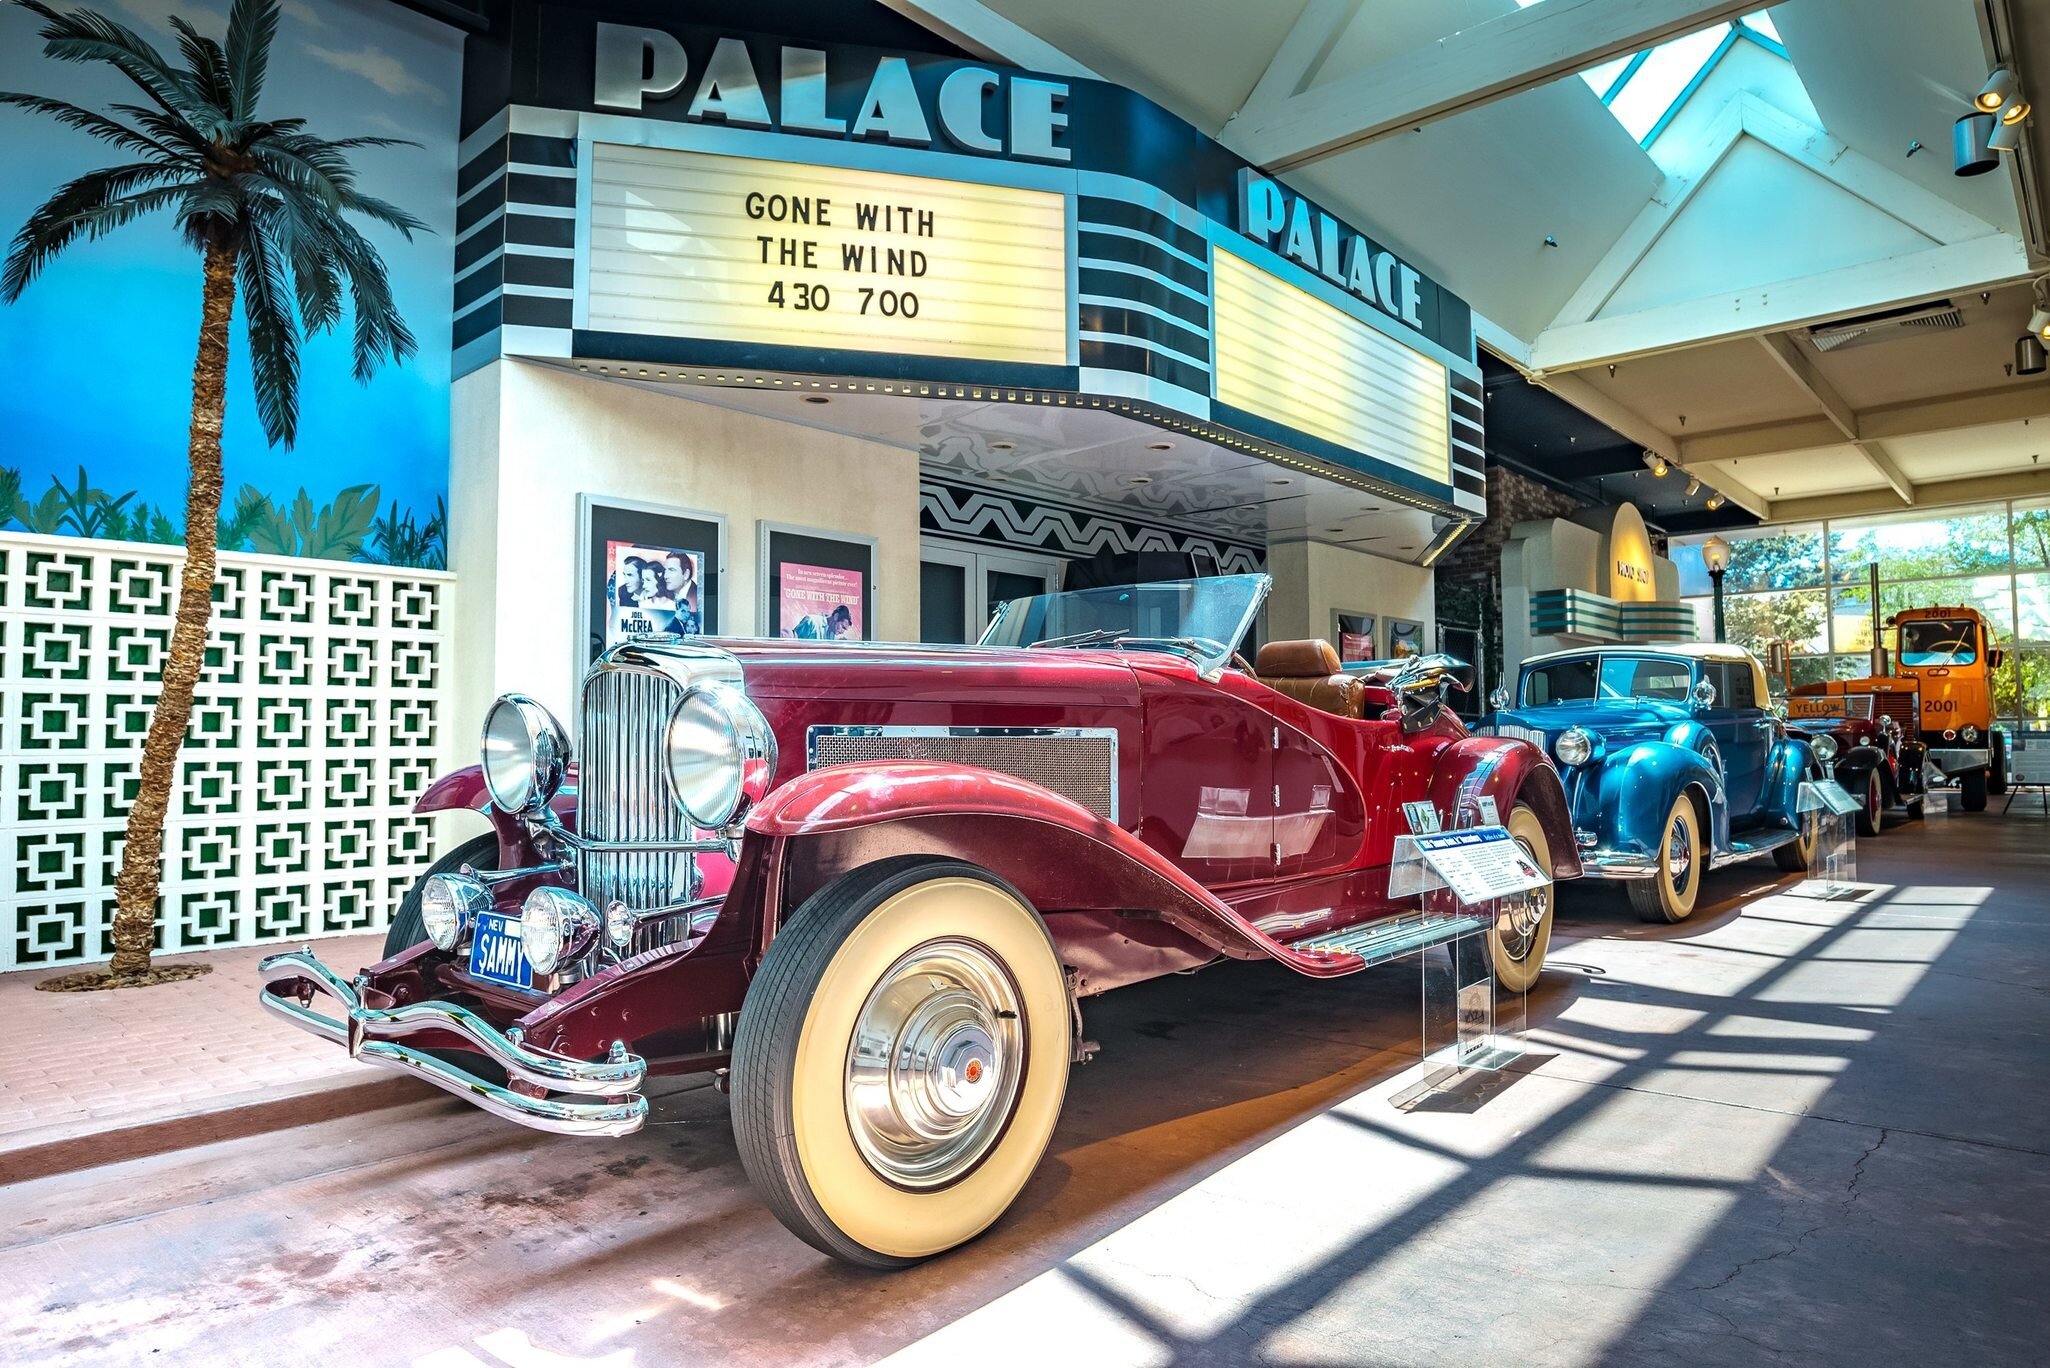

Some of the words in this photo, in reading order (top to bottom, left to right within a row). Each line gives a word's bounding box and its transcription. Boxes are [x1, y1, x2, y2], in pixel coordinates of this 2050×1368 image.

[594, 21, 1072, 163] PALACE
[745, 191, 832, 227] GONE
[855, 202, 934, 238] WITH
[1238, 166, 1422, 330] PALACE
[757, 236, 818, 269] THE
[841, 243, 927, 278] WIND
[768, 281, 830, 312] 430
[858, 287, 919, 319] 700
[807, 590, 825, 601] WITH
[825, 592, 840, 603] THE
[631, 611, 643, 619] JOEL
[1924, 610, 1951, 618] 2001
[621, 618, 653, 633] McCREA
[1796, 703, 1840, 713] YELLOW
[1925, 700, 1957, 712] 2001
[488, 918, 504, 932] NEV
[478, 933, 525, 984] SAMMY
